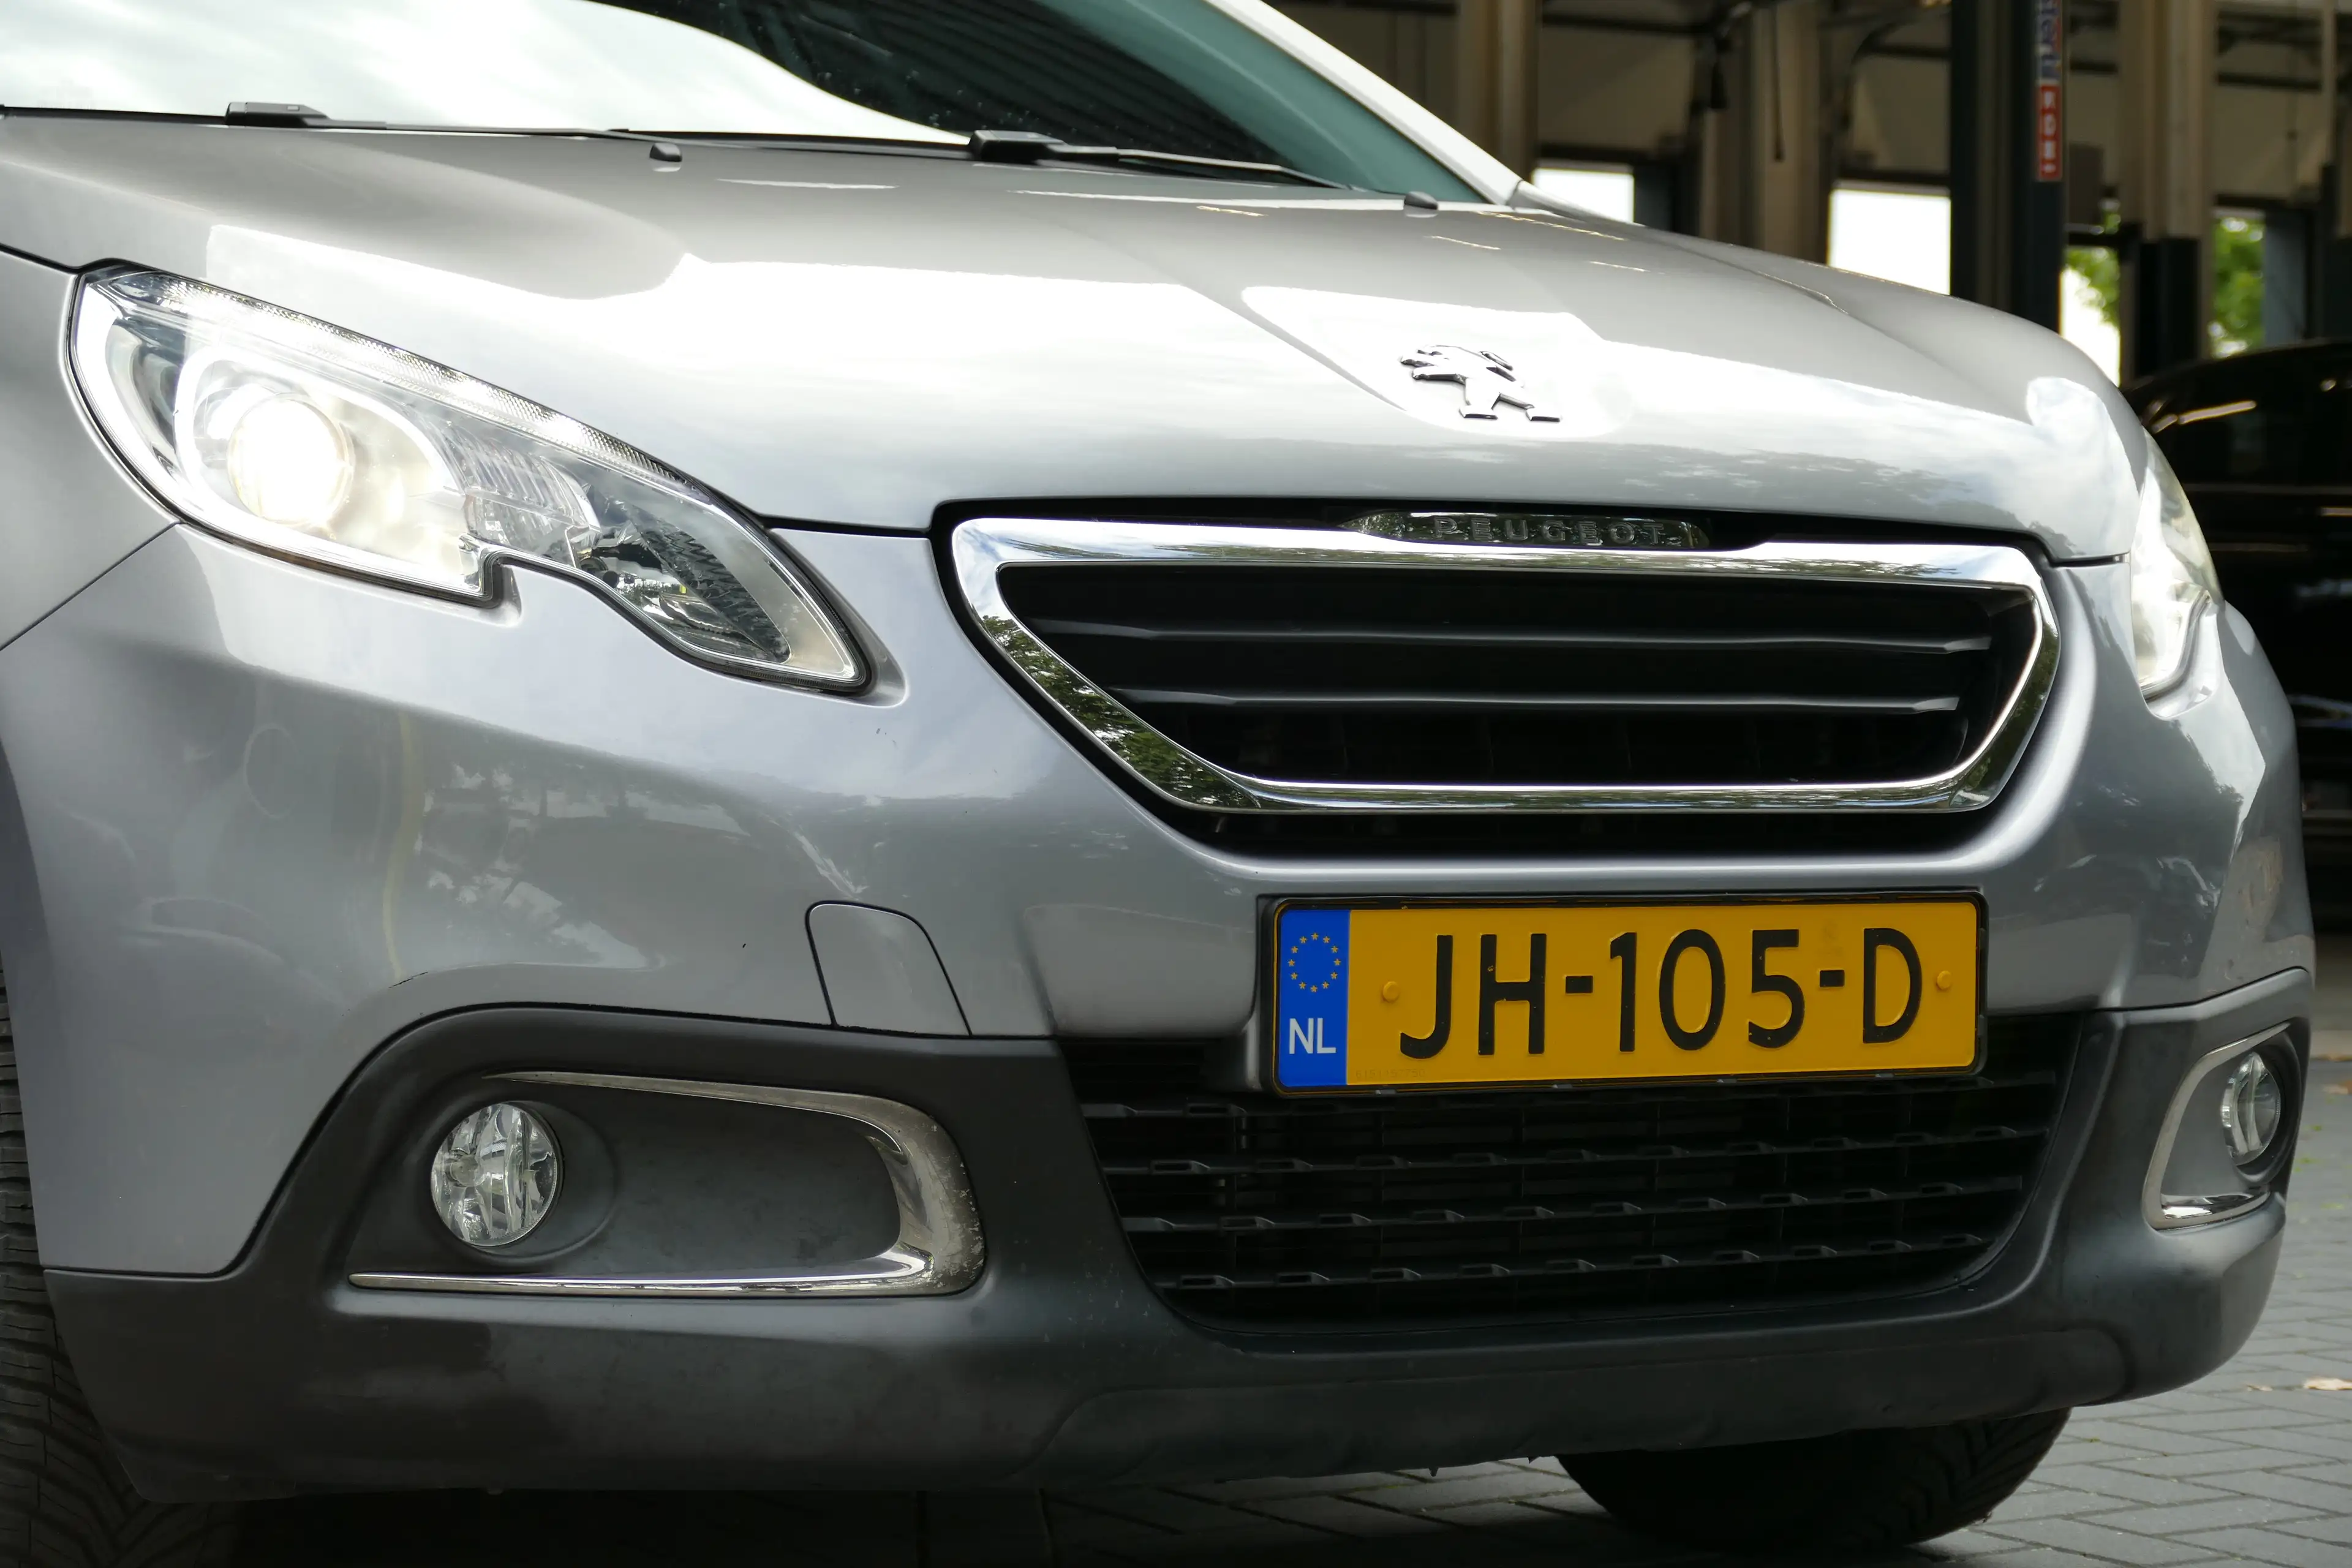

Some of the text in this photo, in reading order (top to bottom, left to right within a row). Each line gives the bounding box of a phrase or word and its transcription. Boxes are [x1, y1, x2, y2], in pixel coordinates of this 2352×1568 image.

[1433, 516, 1664, 546] PEUGEOT
[1399, 927, 1923, 1060] JH-105-D
[1289, 1017, 1336, 1054] NL
